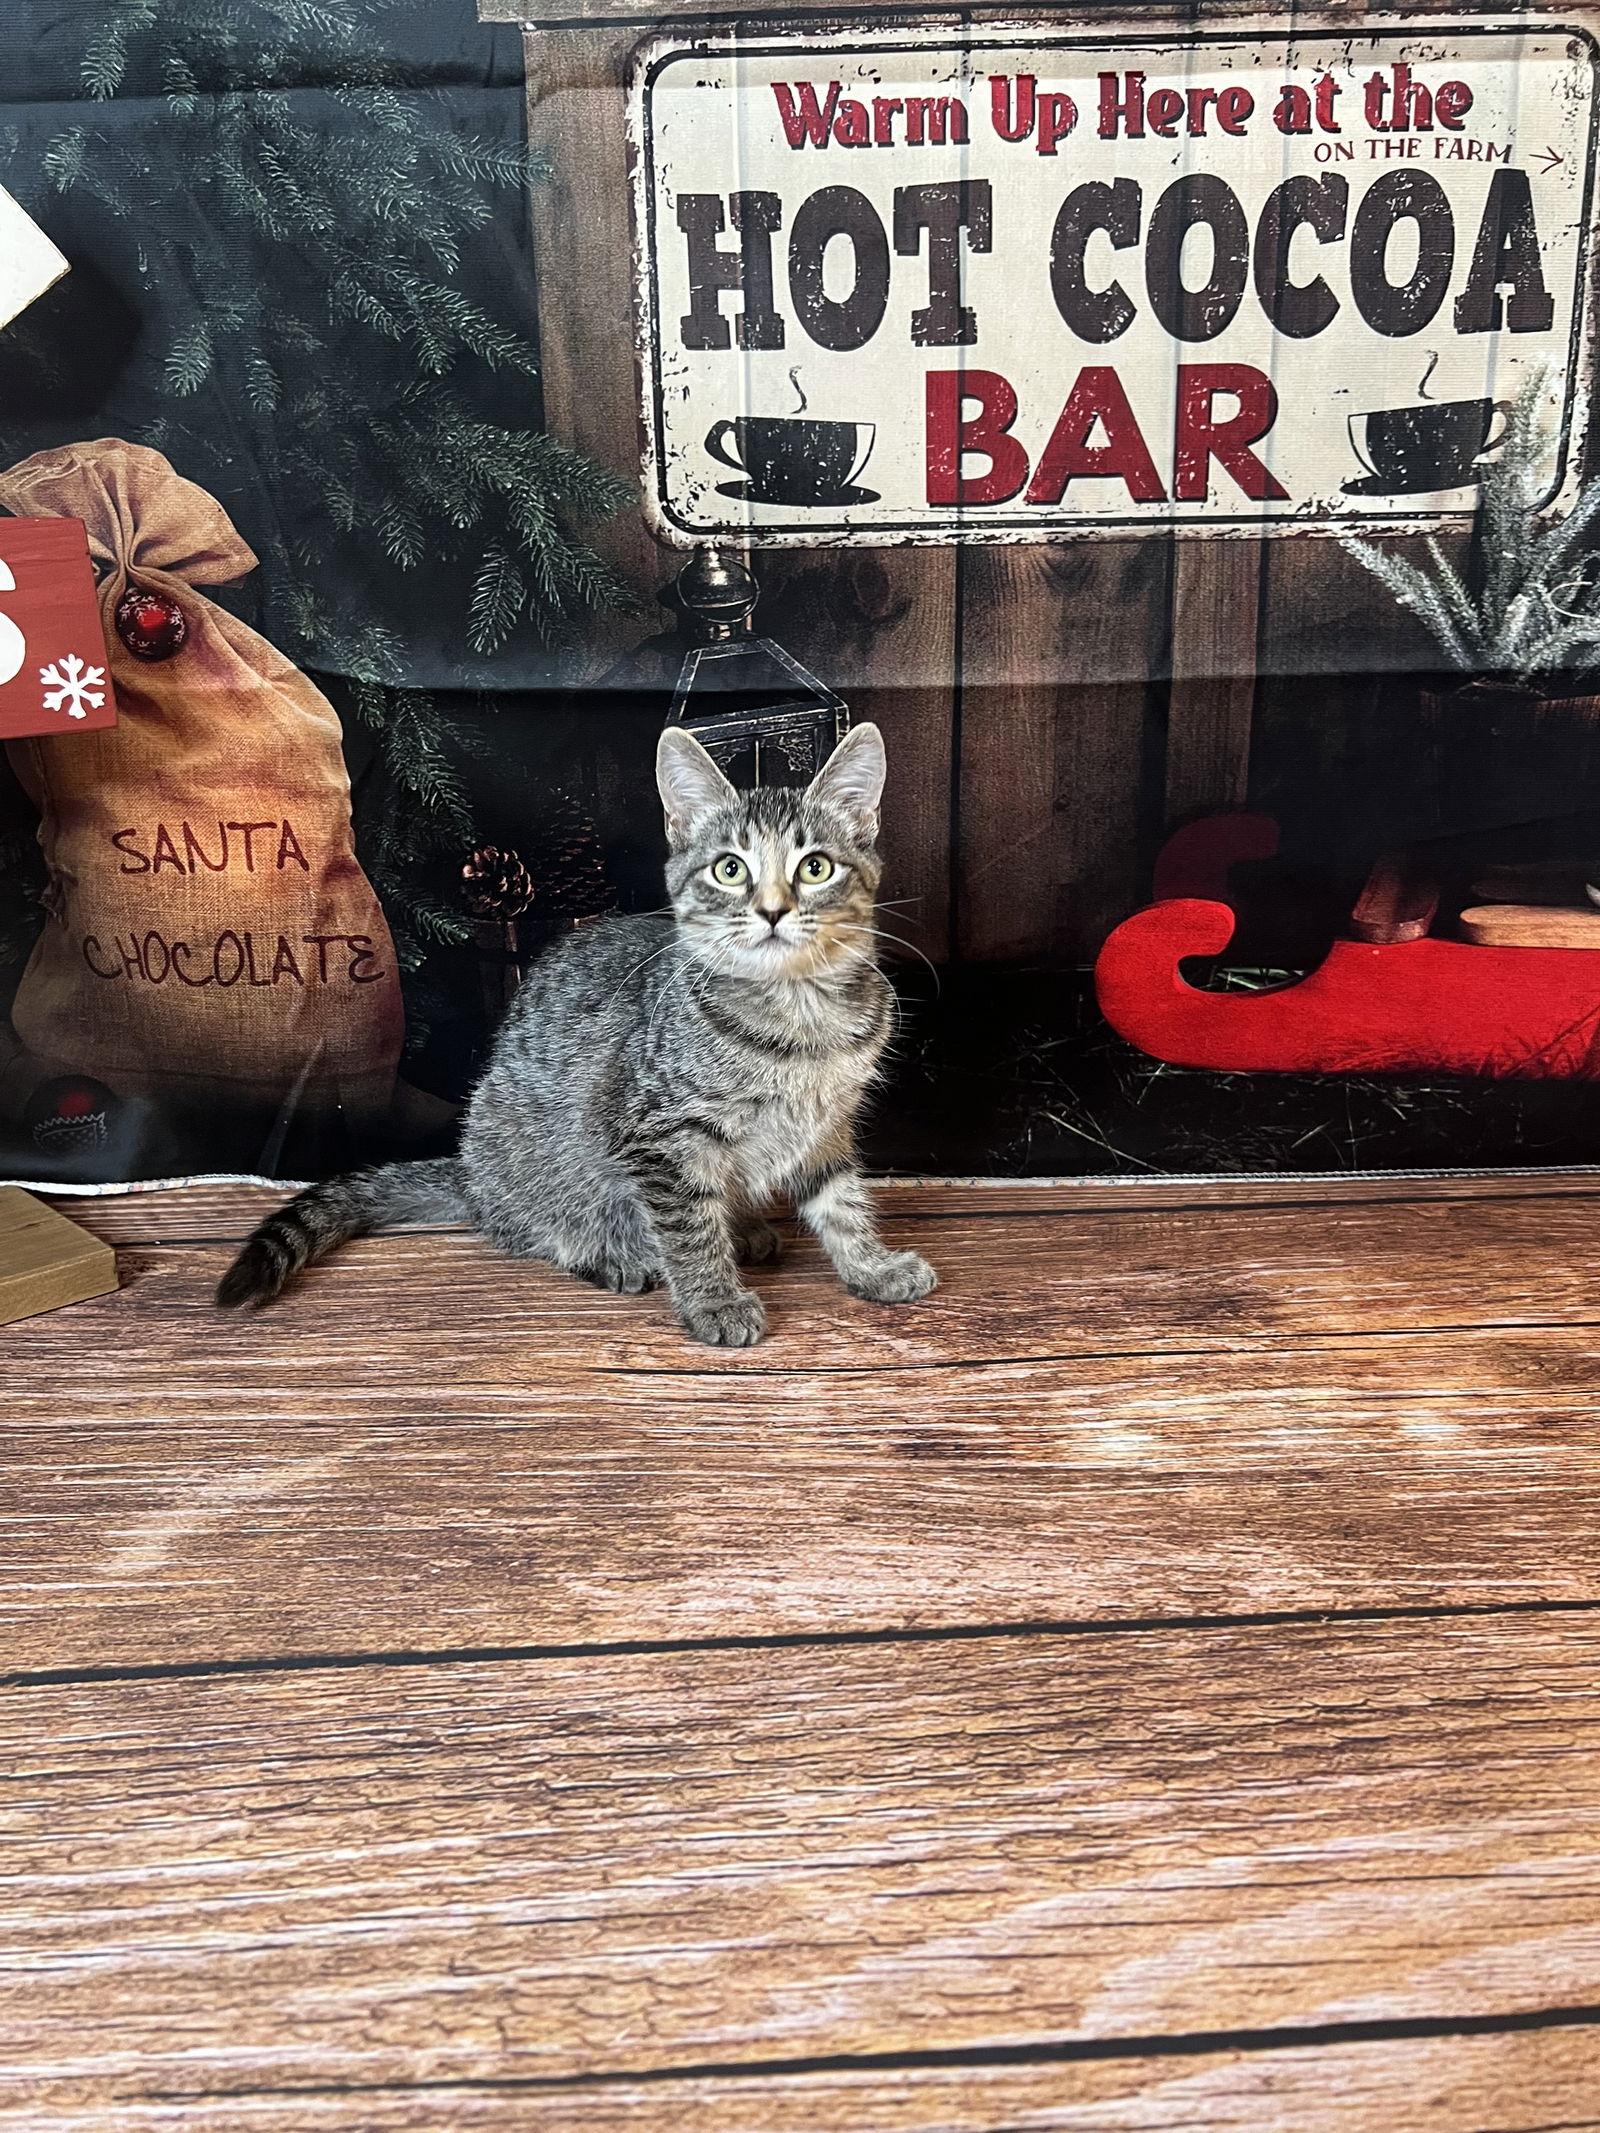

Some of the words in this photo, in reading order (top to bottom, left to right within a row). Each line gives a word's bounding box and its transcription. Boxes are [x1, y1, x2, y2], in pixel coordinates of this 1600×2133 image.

[772, 81, 970, 149] Warm
[987, 74, 1079, 156] Up
[1097, 71, 1255, 139] Here
[1273, 71, 1342, 135] at
[1363, 63, 1474, 133] the
[1314, 140, 1355, 162] ON
[1365, 138, 1422, 160] THE
[1434, 138, 1512, 163] FARM
[677, 179, 993, 351] HOT
[1049, 168, 1555, 345] COCOA
[925, 363, 1292, 508] BAR
[112, 819, 310, 876] SANTA
[82, 929, 387, 987] CHOCOLATE
